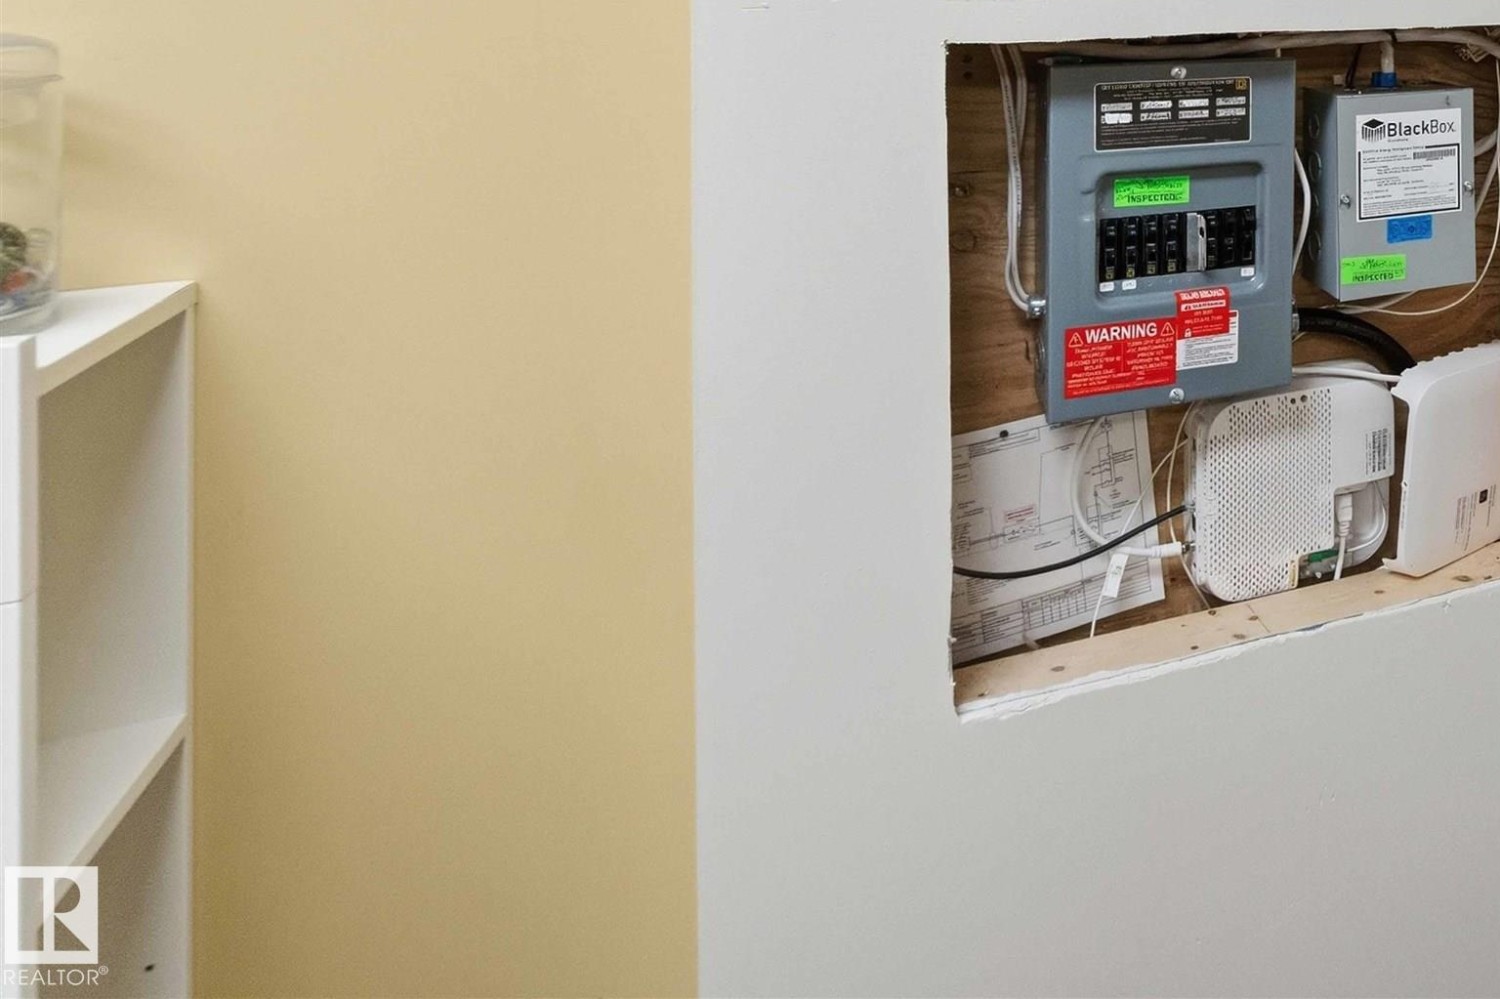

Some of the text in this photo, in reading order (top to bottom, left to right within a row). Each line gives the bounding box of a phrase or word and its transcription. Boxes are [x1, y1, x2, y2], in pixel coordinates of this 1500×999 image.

[1387, 119, 1455, 137] BlackBox
[1127, 193, 1176, 203] INSPECTED
[1085, 323, 1158, 344] WARNING
